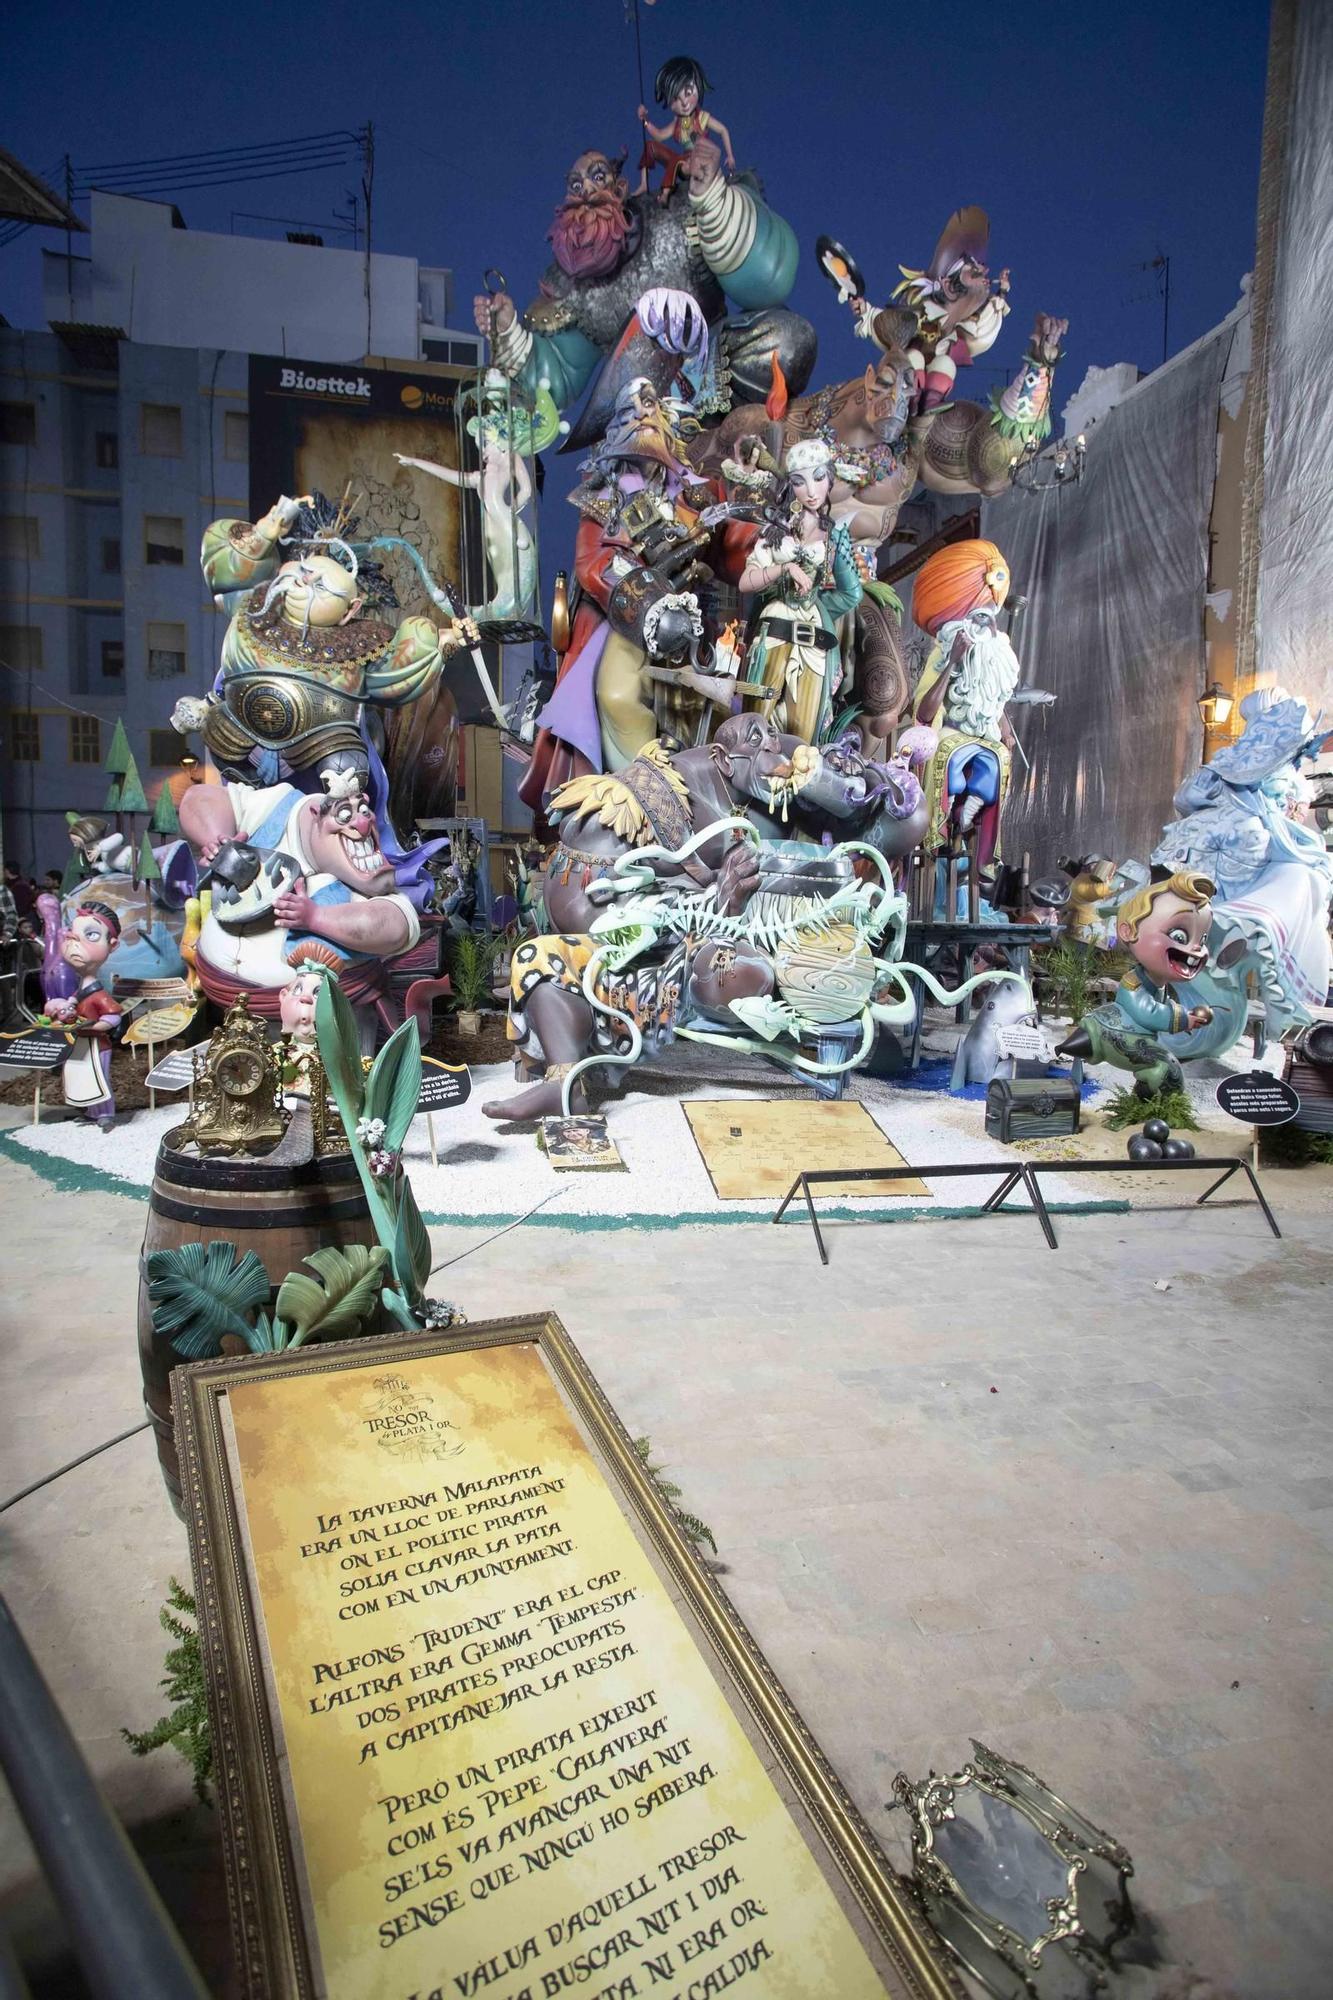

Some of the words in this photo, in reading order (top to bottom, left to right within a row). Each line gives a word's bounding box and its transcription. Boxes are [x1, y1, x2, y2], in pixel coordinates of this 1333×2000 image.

[280, 368, 371, 396] Biosttek
[363, 1410, 433, 1433] TRESOR
[392, 1425, 426, 1438] PLATA
[436, 1420, 461, 1430] OR
[300, 1537, 342, 1558] ERA
[350, 1527, 381, 1545] UN
[383, 1514, 431, 1537] LLOC
[436, 1508, 462, 1523] DE
[465, 1478, 566, 1515] PARLAMENT
[317, 1514, 342, 1534] LA
[349, 1491, 438, 1522] TAVERNA
[443, 1466, 542, 1502] MALAPATA
[340, 1553, 373, 1570] ON
[375, 1545, 402, 1562] EL
[406, 1524, 479, 1553] POLÍTIC
[483, 1505, 548, 1532] PIRATA
[339, 1569, 399, 1598] SOLIA
[404, 1547, 486, 1577] CLAVAR
[485, 1538, 510, 1554] LA
[514, 1522, 562, 1545] PATA
[338, 1598, 380, 1621] COM
[385, 1588, 421, 1608] EN
[513, 1594, 553, 1618] ERA
[556, 1585, 584, 1602] EL
[309, 1672, 404, 1714] L'ALTRA
[409, 1656, 454, 1682] ERA
[460, 1628, 533, 1665] GEMMA
[356, 1702, 401, 1729] DOS
[405, 1668, 498, 1713] PIRATES
[501, 1619, 626, 1678] PREOCUPATS
[358, 1741, 378, 1766] A
[386, 1683, 542, 1750] CAPITANEJAR
[541, 1669, 569, 1692] LA
[572, 1642, 639, 1678] RESTA.
[455, 1764, 495, 1789] UN
[495, 1728, 575, 1774] PIRATA
[578, 1690, 658, 1738] EIXERIT
[383, 1853, 453, 1903] SE'LS
[457, 1835, 492, 1864] VA
[496, 1784, 611, 1851] AVANÇAR
[608, 1759, 654, 1790] UNA
[653, 1738, 693, 1768] NIT
[387, 1821, 437, 1857] COM
[442, 1806, 475, 1834] ÉS
[477, 1775, 548, 1818] PEPE
[550, 1715, 668, 1781] "CALAVERA"
[378, 1890, 466, 1949] SENSE
[469, 1863, 520, 1900] QUE
[519, 1821, 595, 1875] NINGÚ
[600, 1807, 630, 1834] HO
[545, 1874, 657, 1947] D'AQUELL
[658, 1825, 747, 1882] TRESOR
[540, 1929, 644, 1999] BUSCAR
[636, 1898, 682, 1939] NIT
[685, 1891, 700, 1912] I
[641, 1952, 676, 1985] NI
[677, 1918, 728, 1964] ERA
